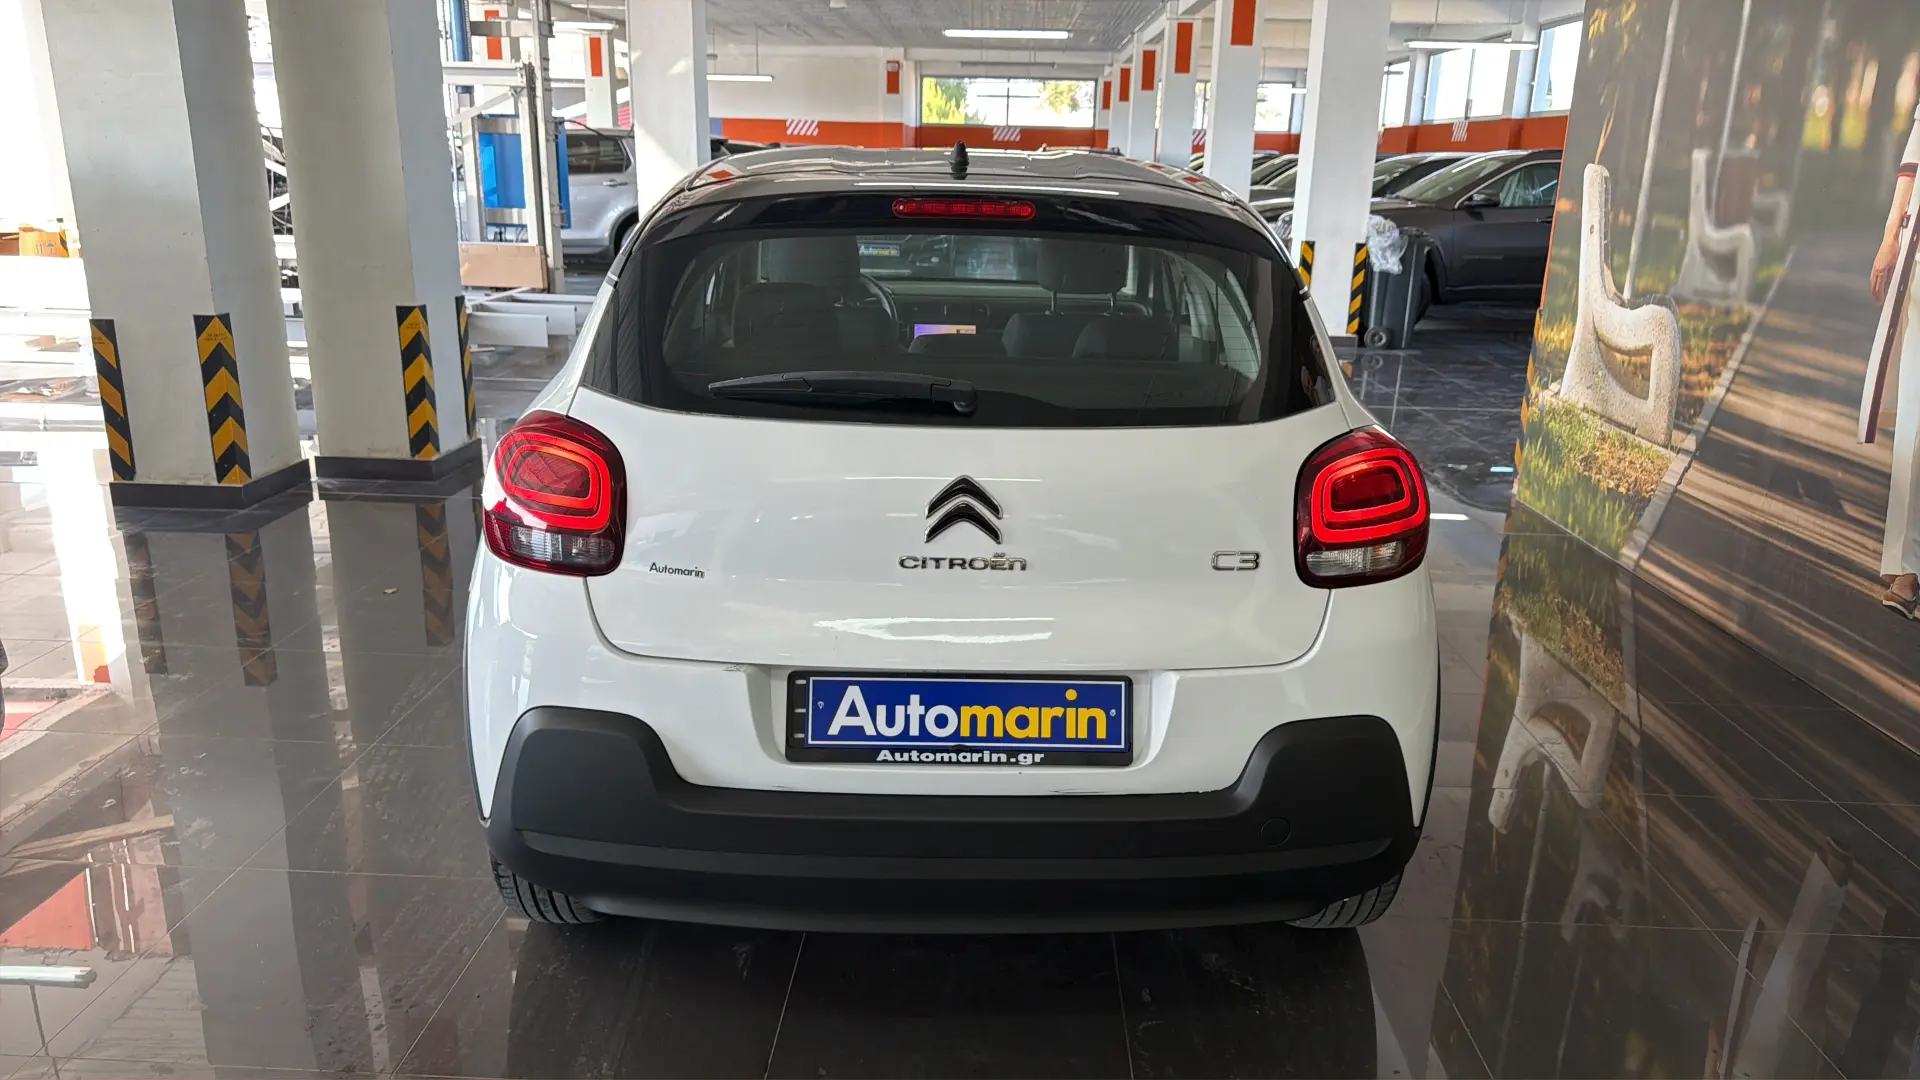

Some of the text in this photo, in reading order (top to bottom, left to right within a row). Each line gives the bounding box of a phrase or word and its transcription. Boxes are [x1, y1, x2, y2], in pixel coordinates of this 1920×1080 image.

[649, 562, 705, 578] Automarin
[1211, 551, 1260, 571] C3
[827, 685, 1106, 739] Automarin
[876, 749, 1044, 765] Automarin.gr
